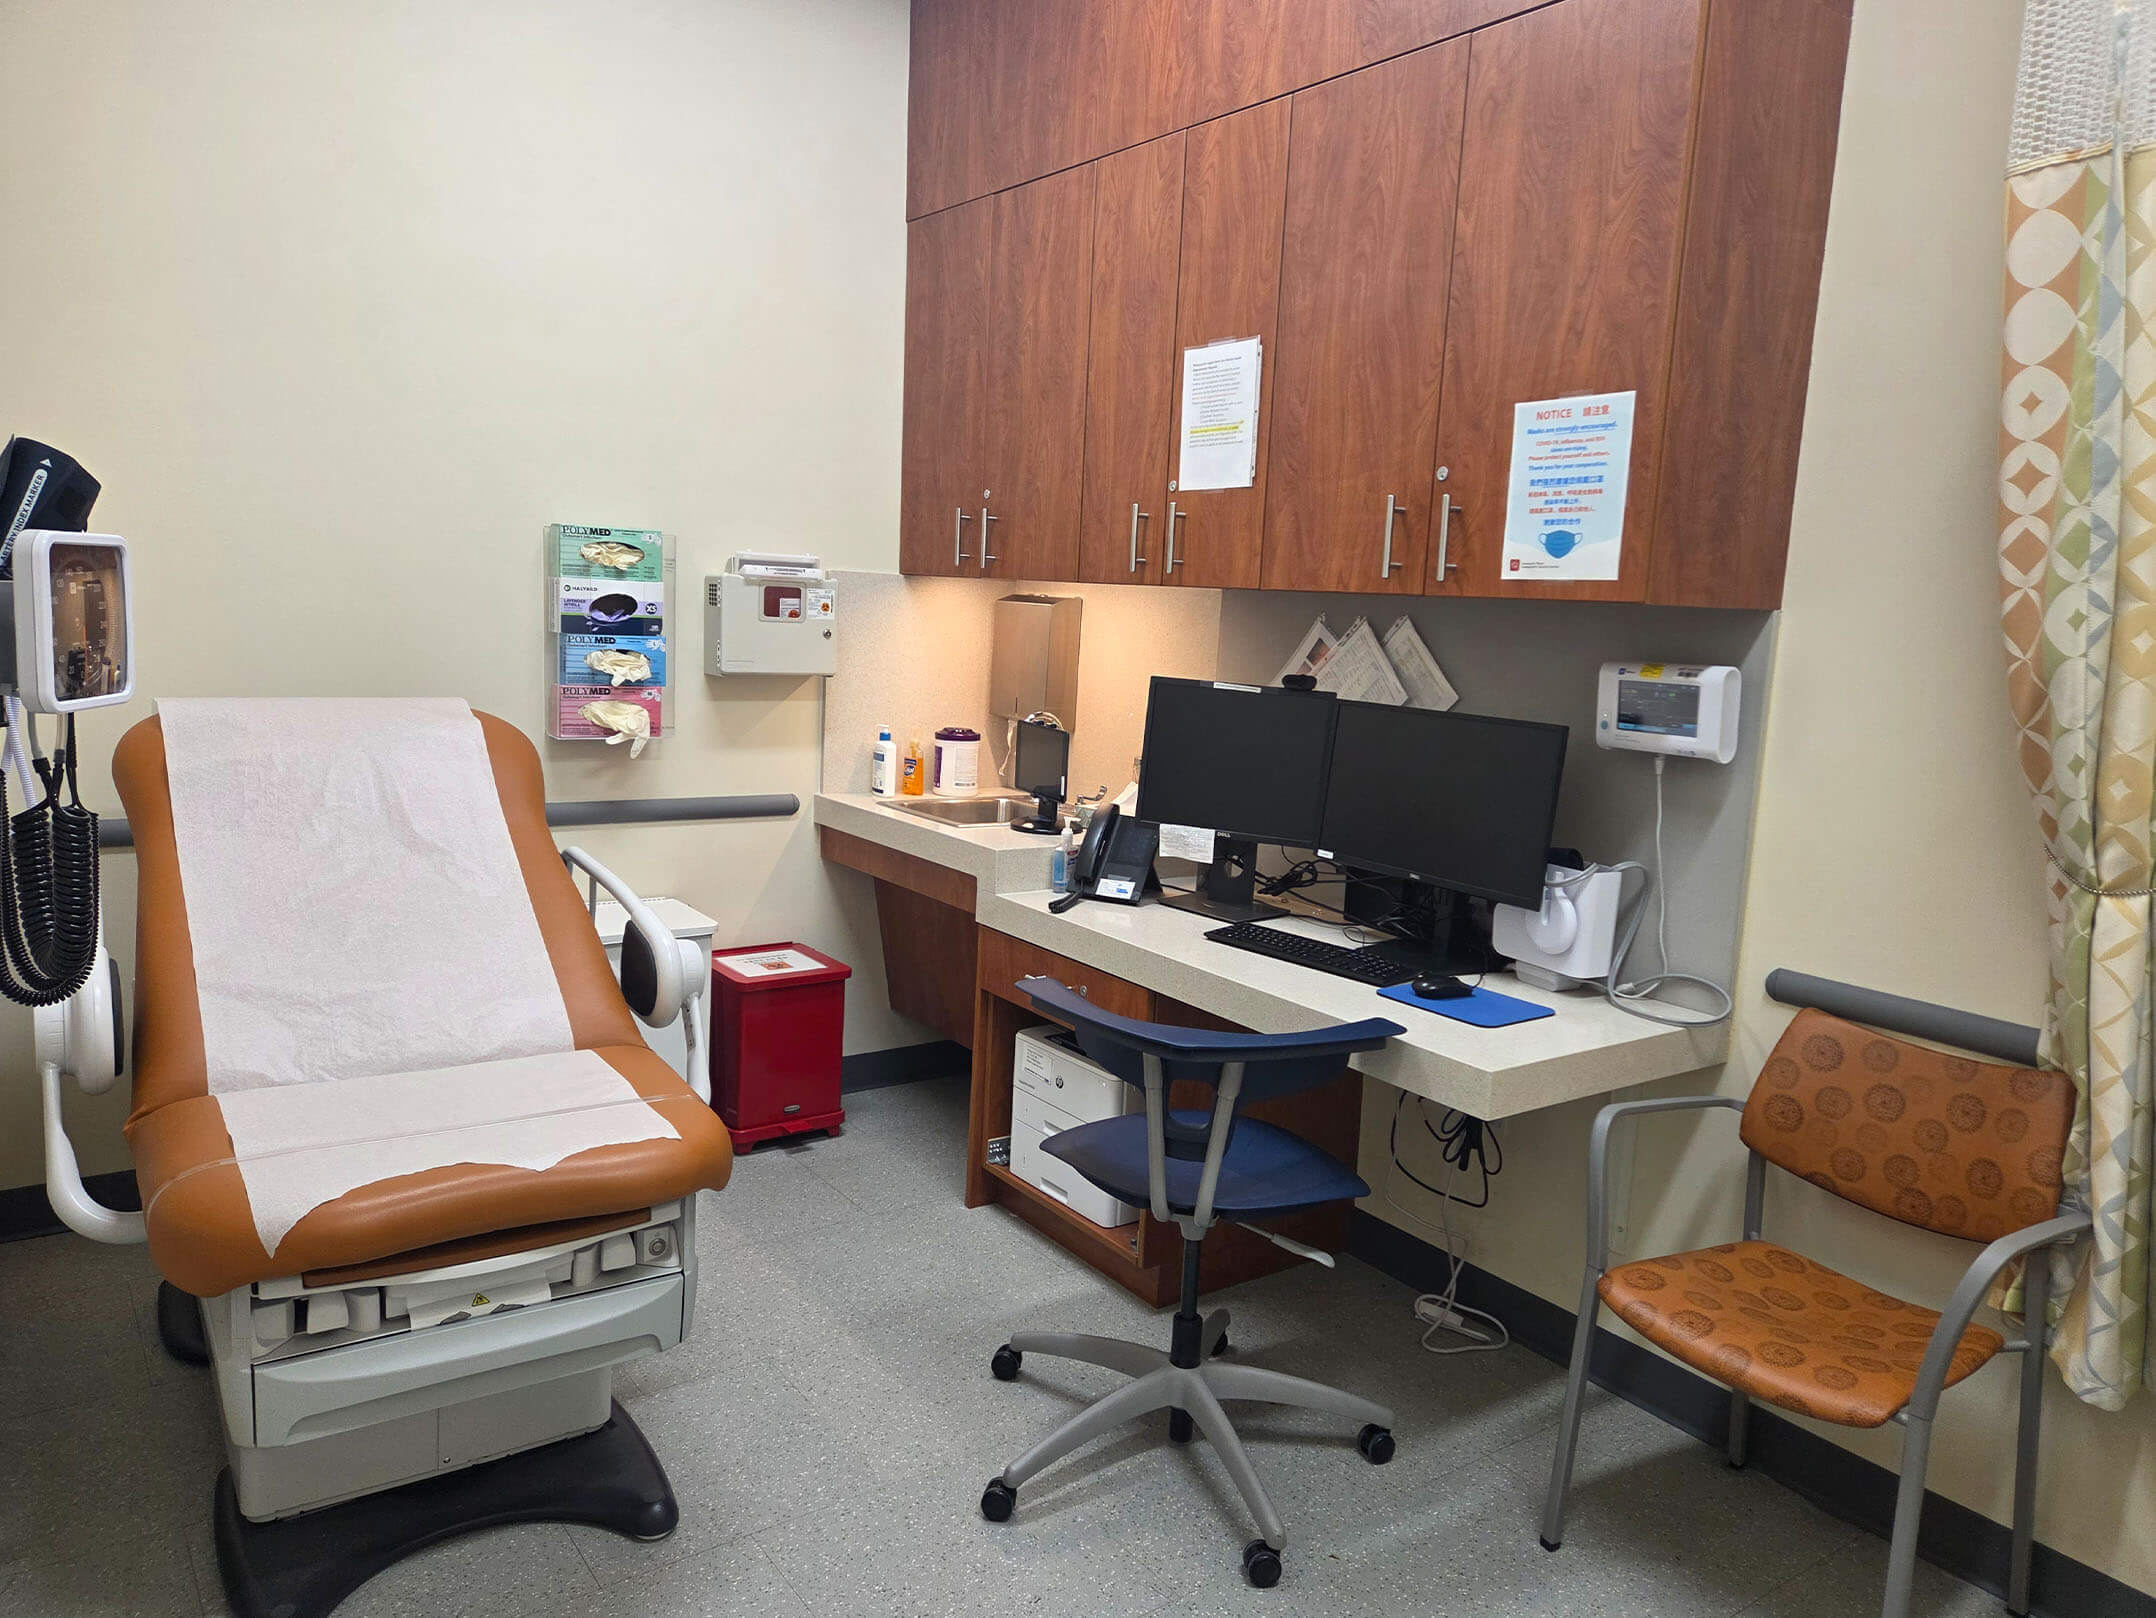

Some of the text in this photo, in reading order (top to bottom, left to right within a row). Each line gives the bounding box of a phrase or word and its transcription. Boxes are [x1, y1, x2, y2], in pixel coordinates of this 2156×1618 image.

[1536, 408, 1572, 420] NOTICE
[1556, 425, 1579, 433] strongly
[1562, 452, 1582, 460] yourself
[0, 474, 45, 561] ARTERY INDEX MARKER
[562, 526, 611, 536] POLYMED
[568, 635, 616, 644] POLYMED
[562, 687, 611, 695] POLYMED
